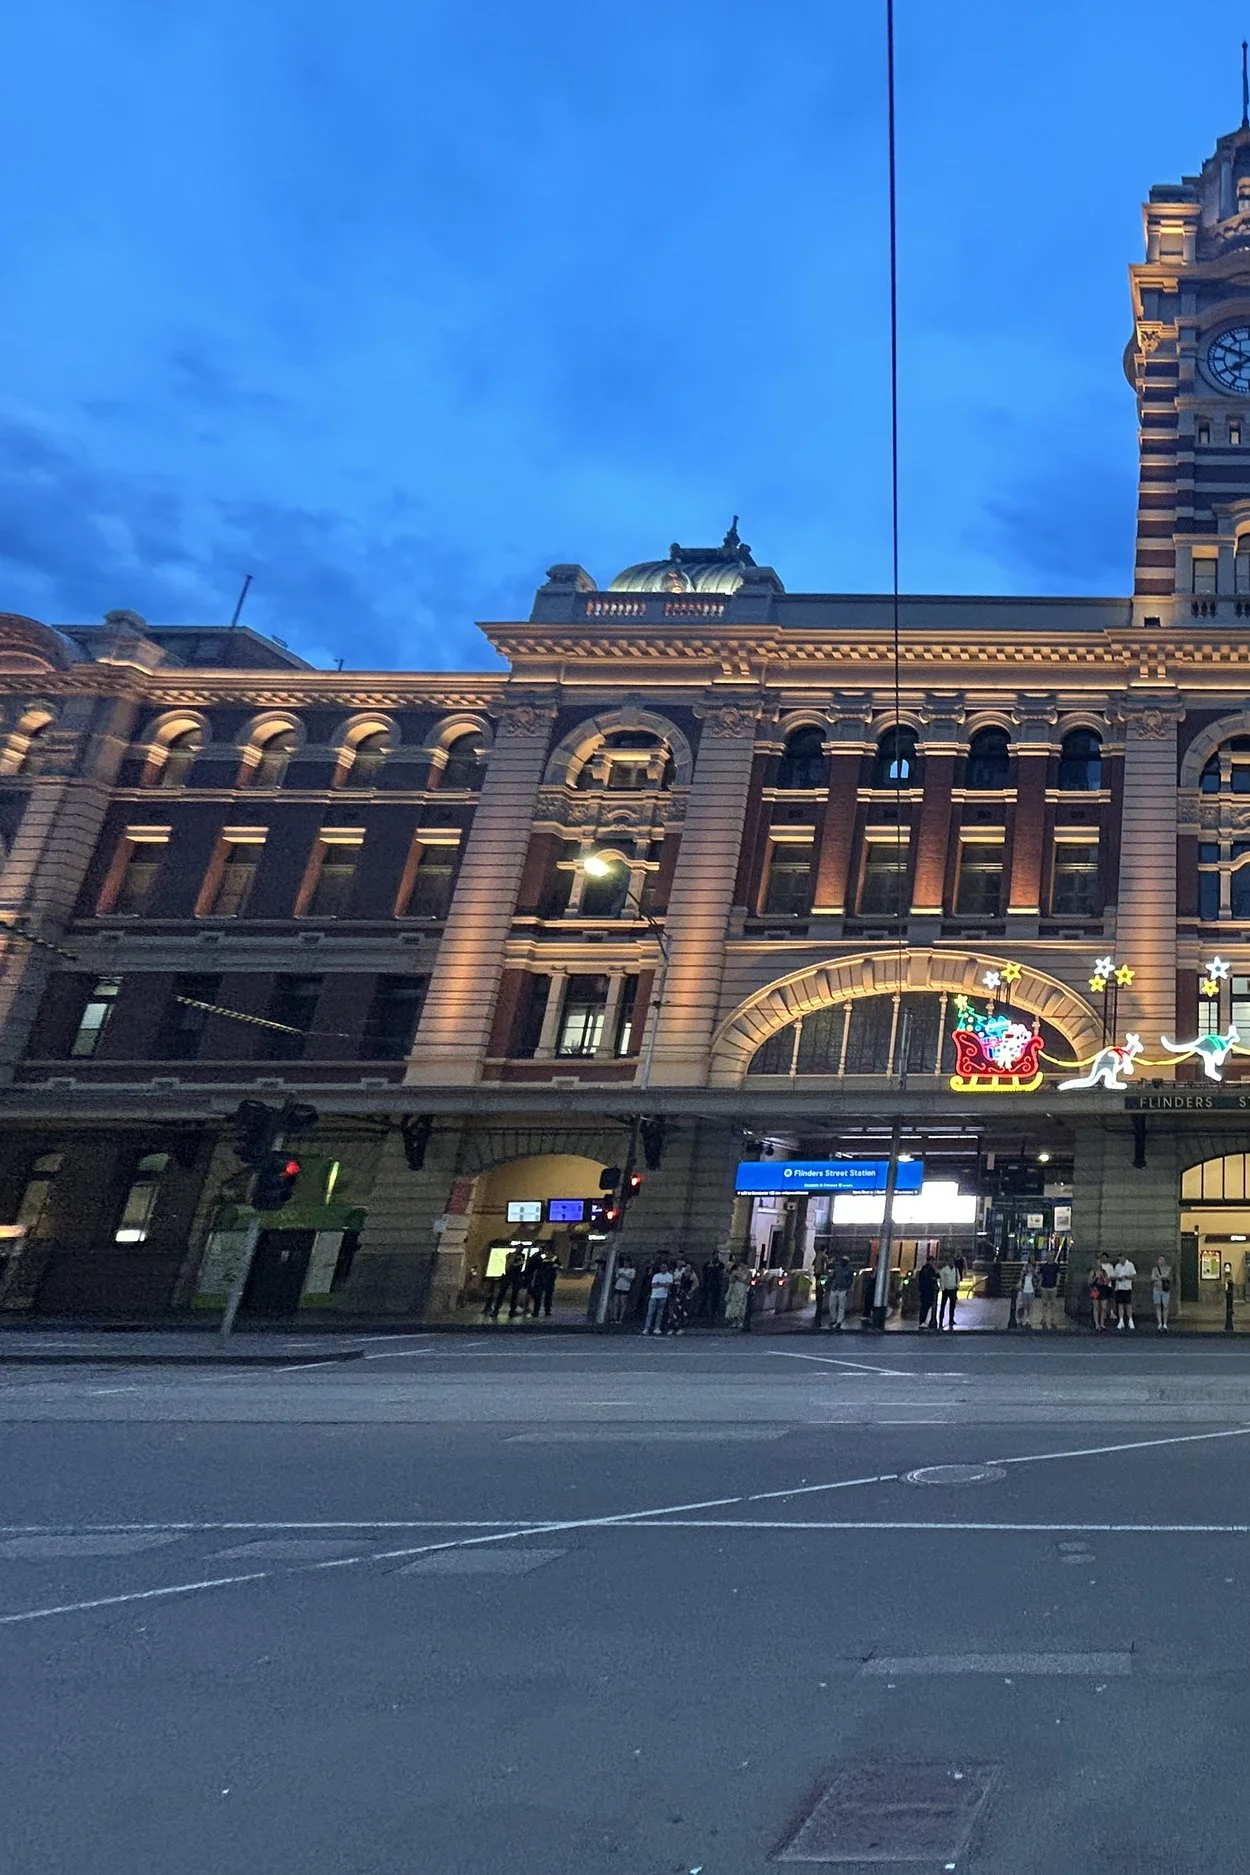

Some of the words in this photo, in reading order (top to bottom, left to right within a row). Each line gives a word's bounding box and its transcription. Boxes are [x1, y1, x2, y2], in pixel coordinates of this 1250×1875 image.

[1140, 1096, 1213, 1108] FLINDERS
[793, 1169, 823, 1177] Flinders
[825, 1169, 848, 1177] Street
[849, 1169, 876, 1177] Station
